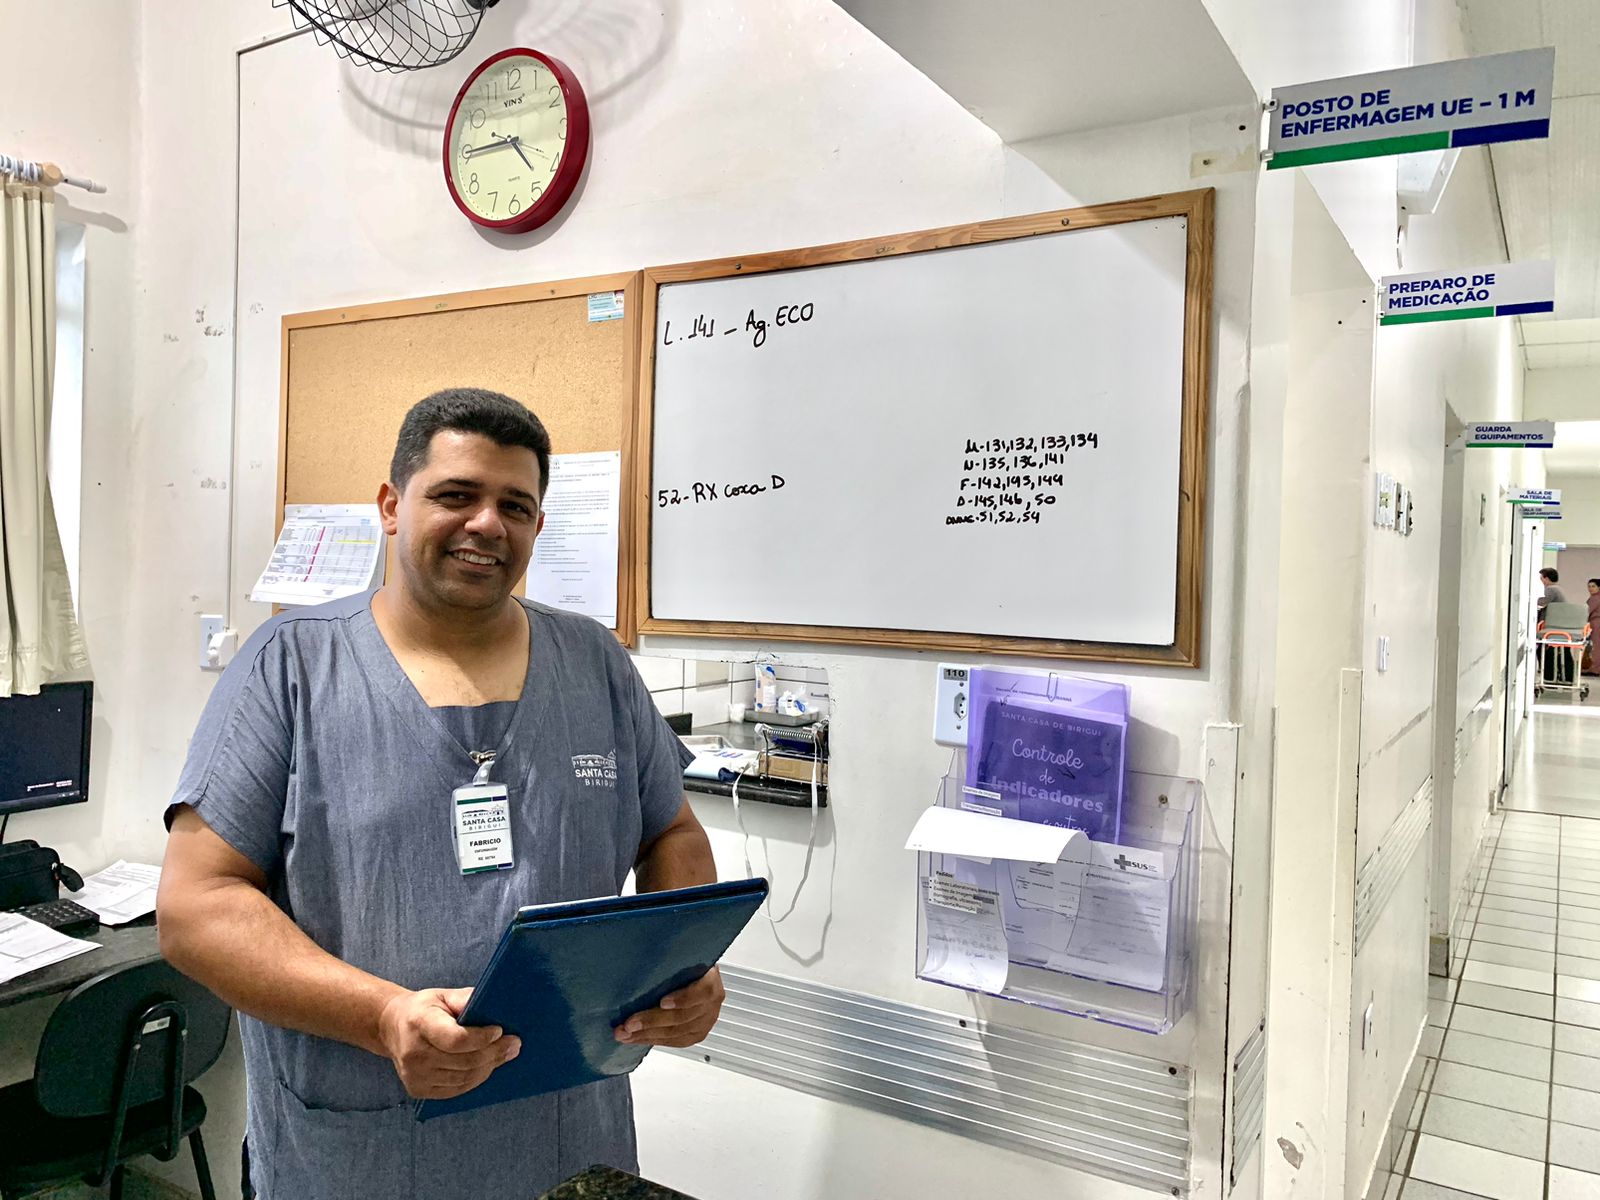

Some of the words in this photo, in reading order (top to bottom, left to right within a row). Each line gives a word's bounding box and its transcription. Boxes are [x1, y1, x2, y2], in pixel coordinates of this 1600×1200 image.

[506, 68, 521, 91] 12
[533, 69, 538, 91] 1
[486, 82, 498, 104] 11
[548, 85, 561, 109] 2
[1281, 95, 1354, 119] POSTO
[1360, 89, 1391, 108] DE
[470, 108, 486, 131] 10
[1281, 106, 1435, 139] ENFERMAGEM
[1442, 97, 1473, 117] UE
[1498, 93, 1508, 109] 1
[1514, 89, 1536, 108] M
[558, 117, 568, 141] 3
[462, 143, 473, 165] 9
[549, 151, 560, 173] 4
[469, 172, 480, 195] 8
[530, 181, 543, 203] 5
[487, 191, 499, 213] 7
[508, 194, 521, 215] 6
[1388, 276, 1467, 295] PREPARO
[1471, 273, 1496, 286] DE
[1388, 287, 1490, 310] MEDICAÇÃO
[688, 314, 715, 339] 141
[724, 483, 767, 499] coxa
[771, 475, 786, 490] D
[945, 669, 966, 678] 110
[1001, 711, 1026, 722] SANTA
[1029, 716, 1050, 727] CASA
[1052, 721, 1064, 729] DE
[1067, 724, 1102, 736] BIRIGUI
[1012, 738, 1084, 769] Controle
[575, 768, 603, 778] SANTA
[1039, 768, 1056, 785] de
[989, 775, 1104, 813] Indicadores
[462, 818, 486, 826] SANTA
[469, 837, 502, 847] FABRICIO
[1131, 861, 1149, 870] SUS
